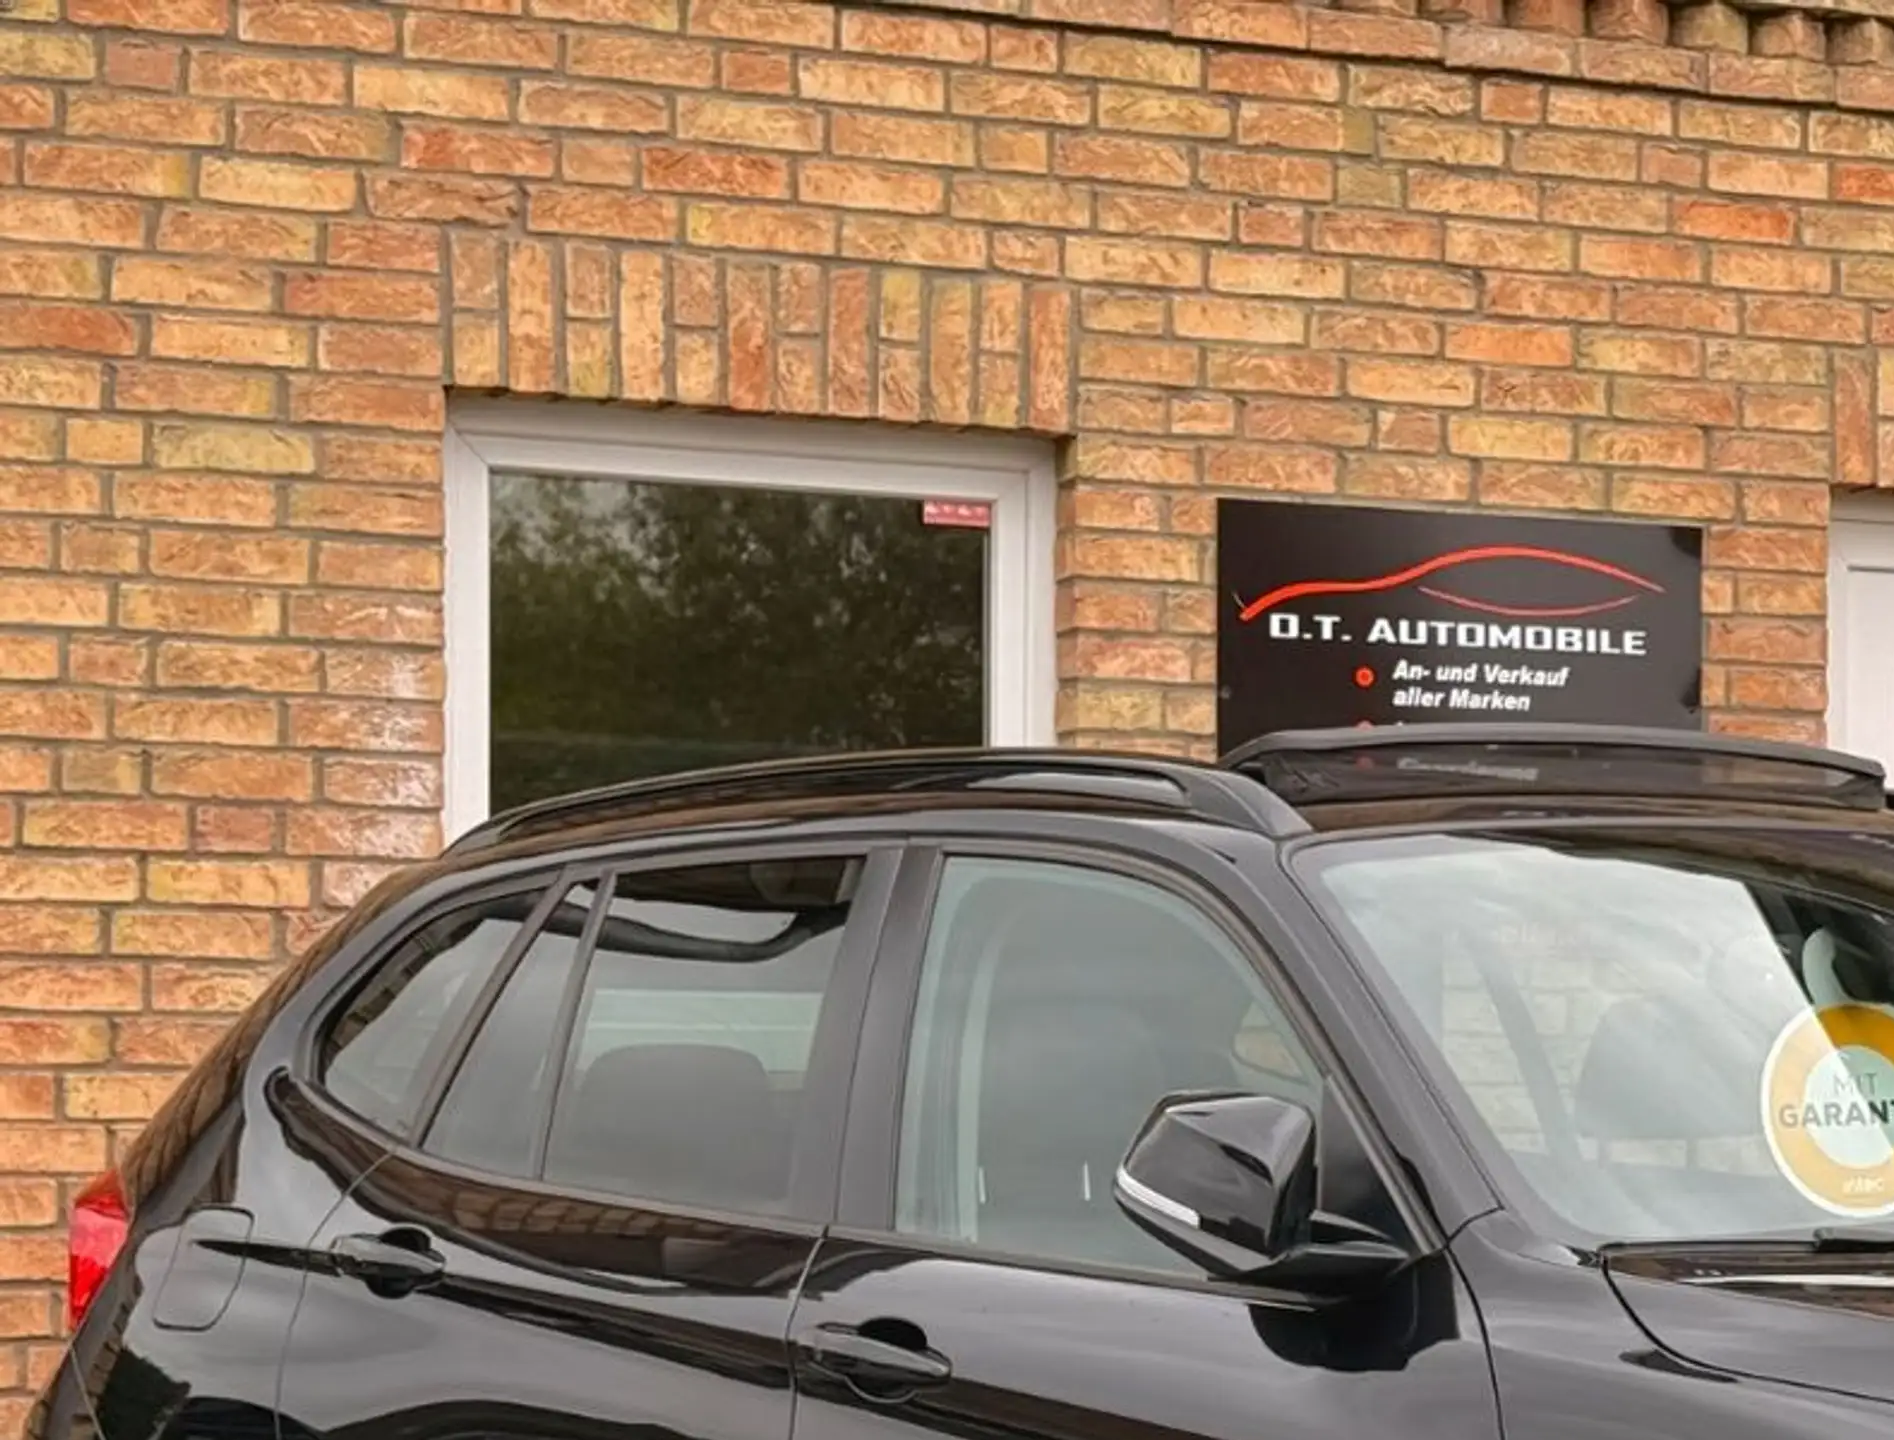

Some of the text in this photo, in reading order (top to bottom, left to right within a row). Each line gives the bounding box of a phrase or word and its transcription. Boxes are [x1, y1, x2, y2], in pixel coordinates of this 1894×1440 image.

[1269, 612, 1648, 656] O.T. AUTOMOBILE
[1391, 658, 1572, 687] An- und Verkauf
[1391, 687, 1532, 712] aller Marken
[1833, 1072, 1878, 1096] MIT
